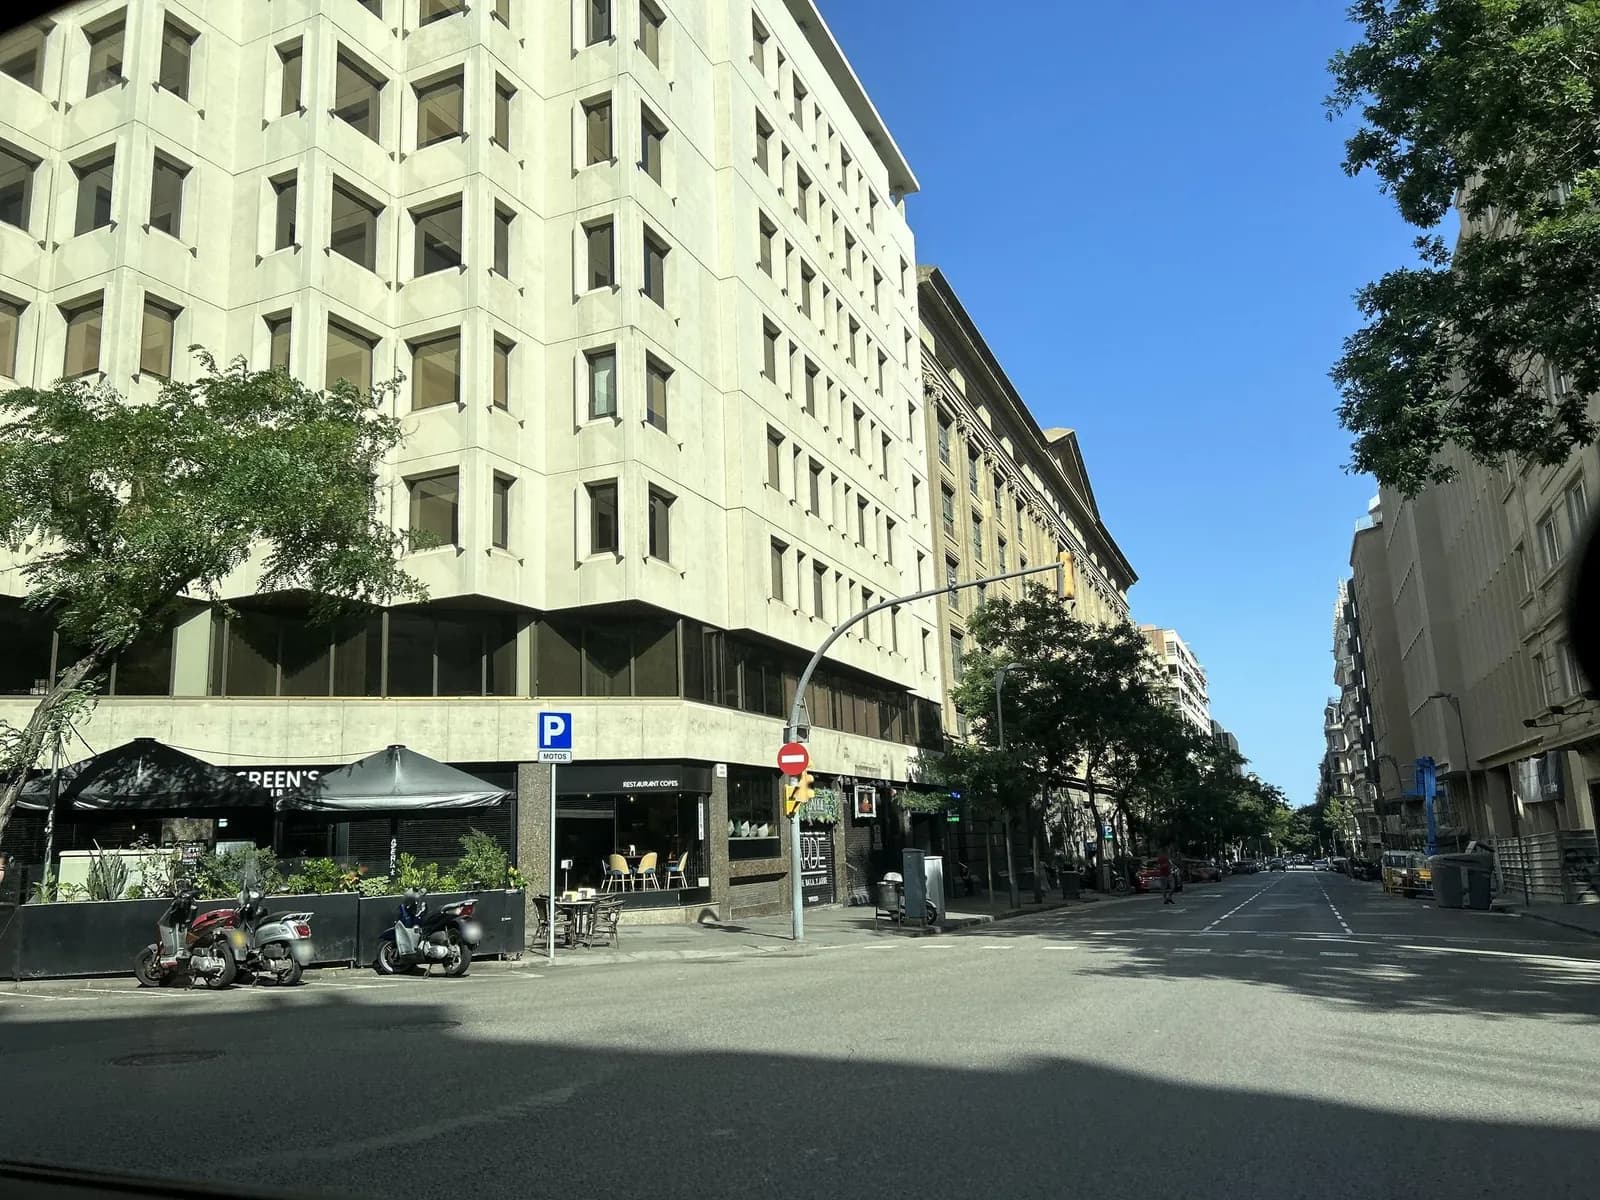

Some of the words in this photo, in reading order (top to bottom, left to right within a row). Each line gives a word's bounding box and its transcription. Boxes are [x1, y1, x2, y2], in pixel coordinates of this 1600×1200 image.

[543, 715, 566, 746] P
[543, 752, 568, 760] MOTOS
[623, 780, 659, 788] RESTAURANT
